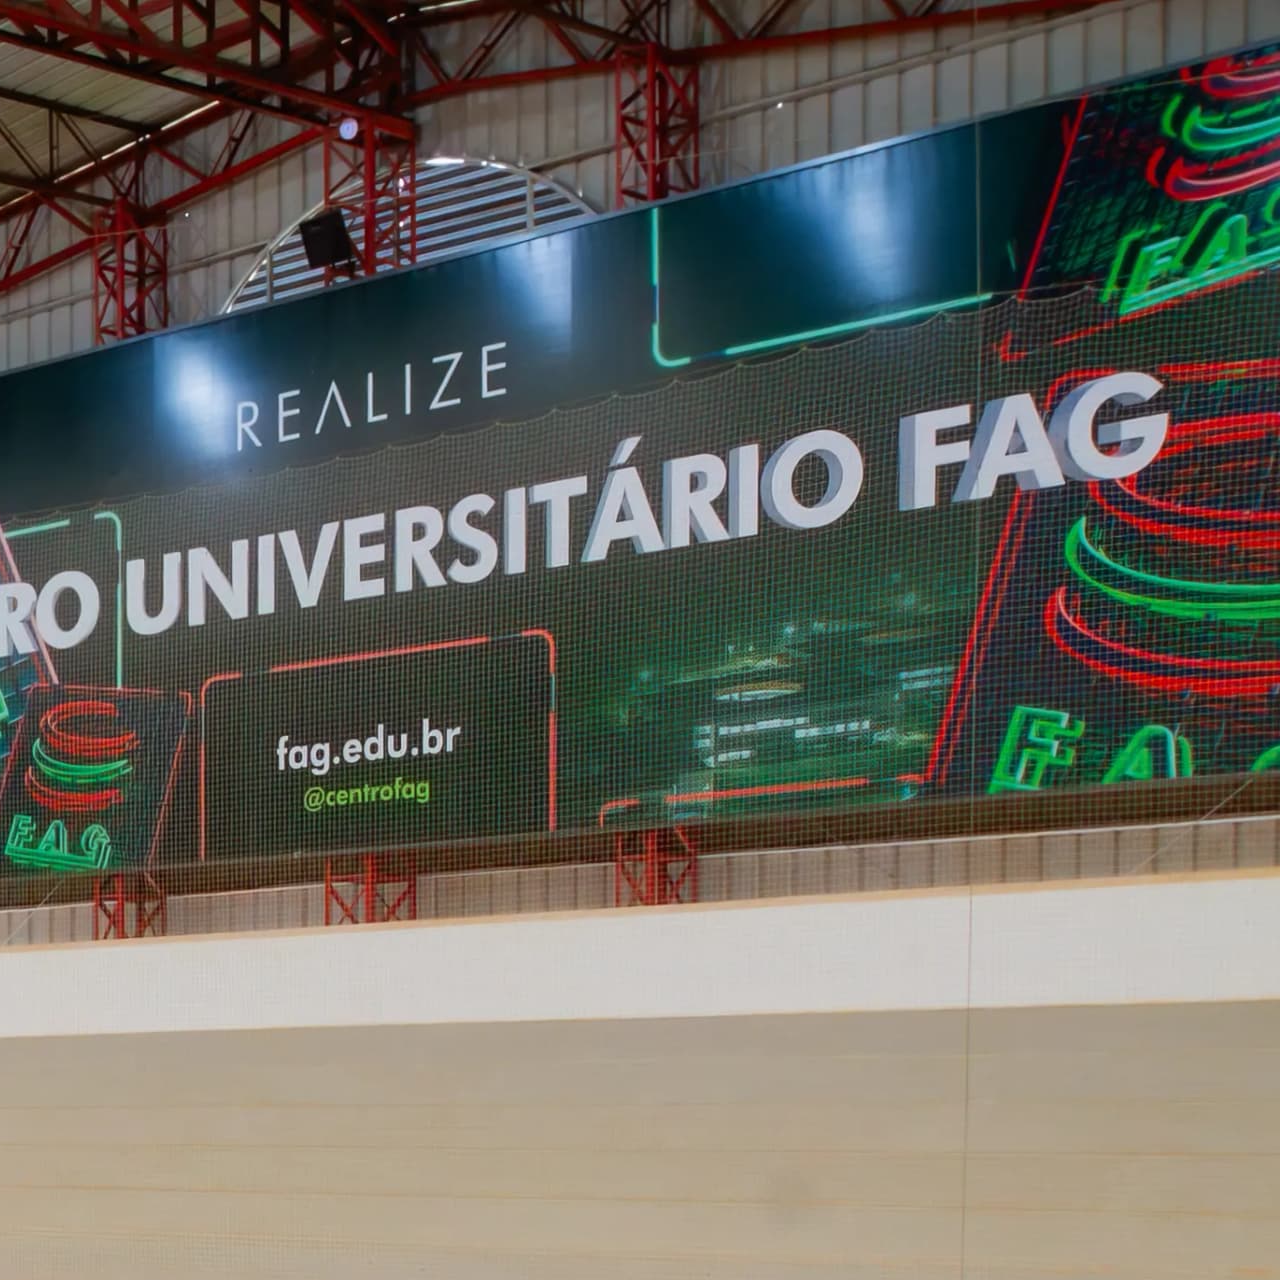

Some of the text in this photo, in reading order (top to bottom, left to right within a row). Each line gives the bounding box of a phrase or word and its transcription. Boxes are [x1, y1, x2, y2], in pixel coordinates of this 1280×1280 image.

[237, 341, 509, 451] REALIZE
[126, 428, 865, 637] UNIVERSITÁRIO
[898, 371, 1171, 512] FAG
[276, 717, 461, 776] fag.edu.br
[303, 777, 430, 812] @centrofag
